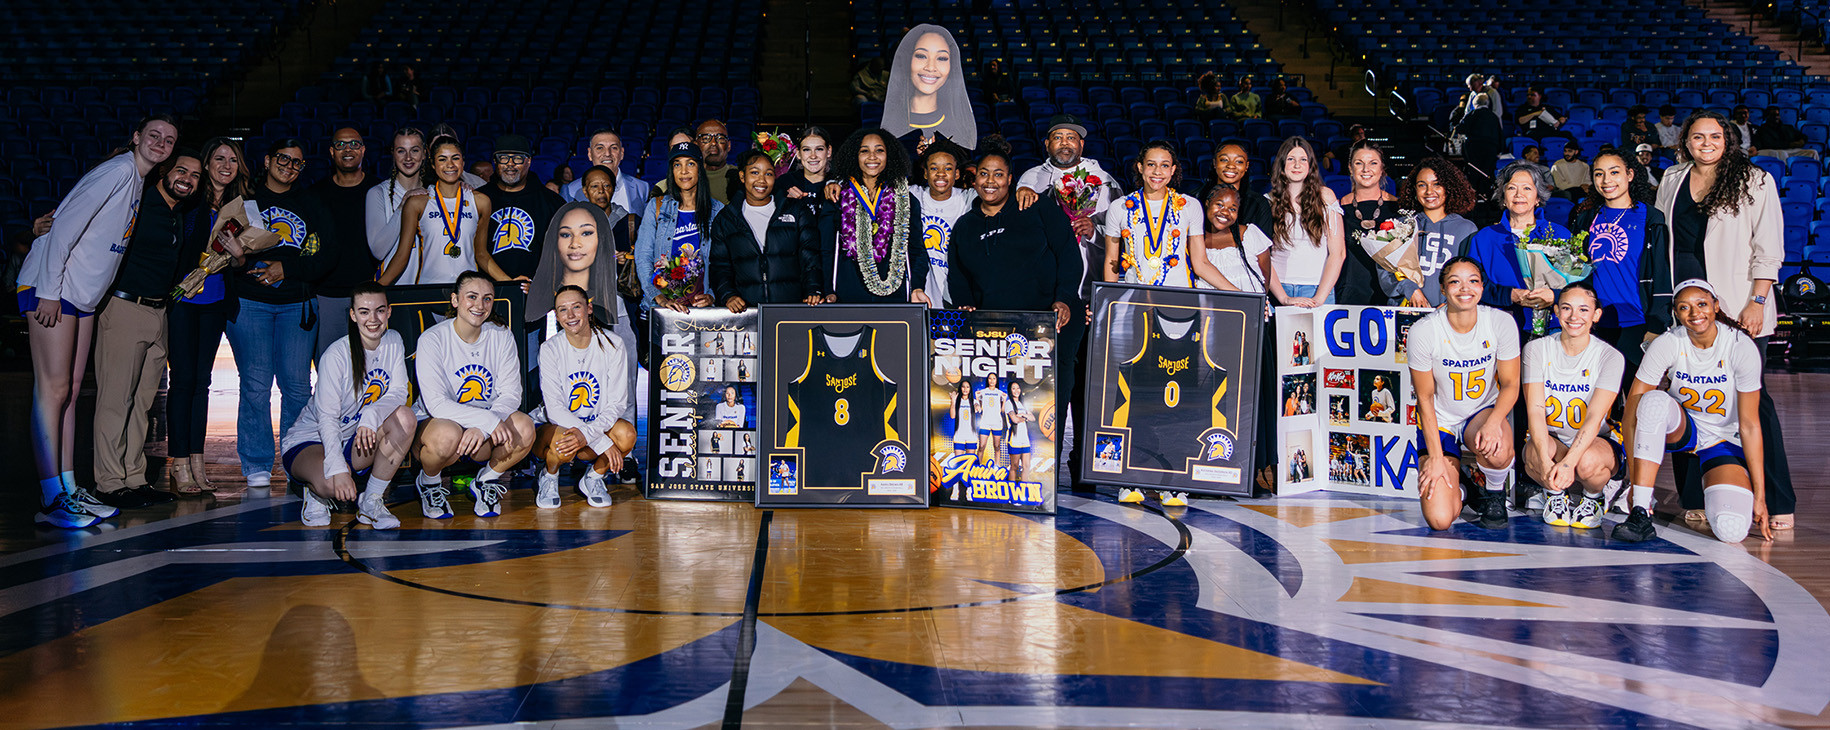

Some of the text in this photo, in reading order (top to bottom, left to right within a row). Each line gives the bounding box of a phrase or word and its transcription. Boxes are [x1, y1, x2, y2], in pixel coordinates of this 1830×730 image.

[673, 318, 745, 331] Amira
[976, 331, 1007, 339] SJSU
[934, 355, 1052, 379] NIGHT
[1442, 354, 1492, 368] SPARTANS
[1448, 367, 1486, 401] 15
[1545, 379, 1590, 393] SARTANS
[1675, 370, 1727, 384] SPARTANS
[1164, 380, 1180, 408] 0
[1678, 386, 1726, 417] 22
[834, 398, 850, 426] 8
[1545, 394, 1588, 430] 20
[941, 453, 1009, 483] Amira
[970, 479, 1044, 503] BROWN
